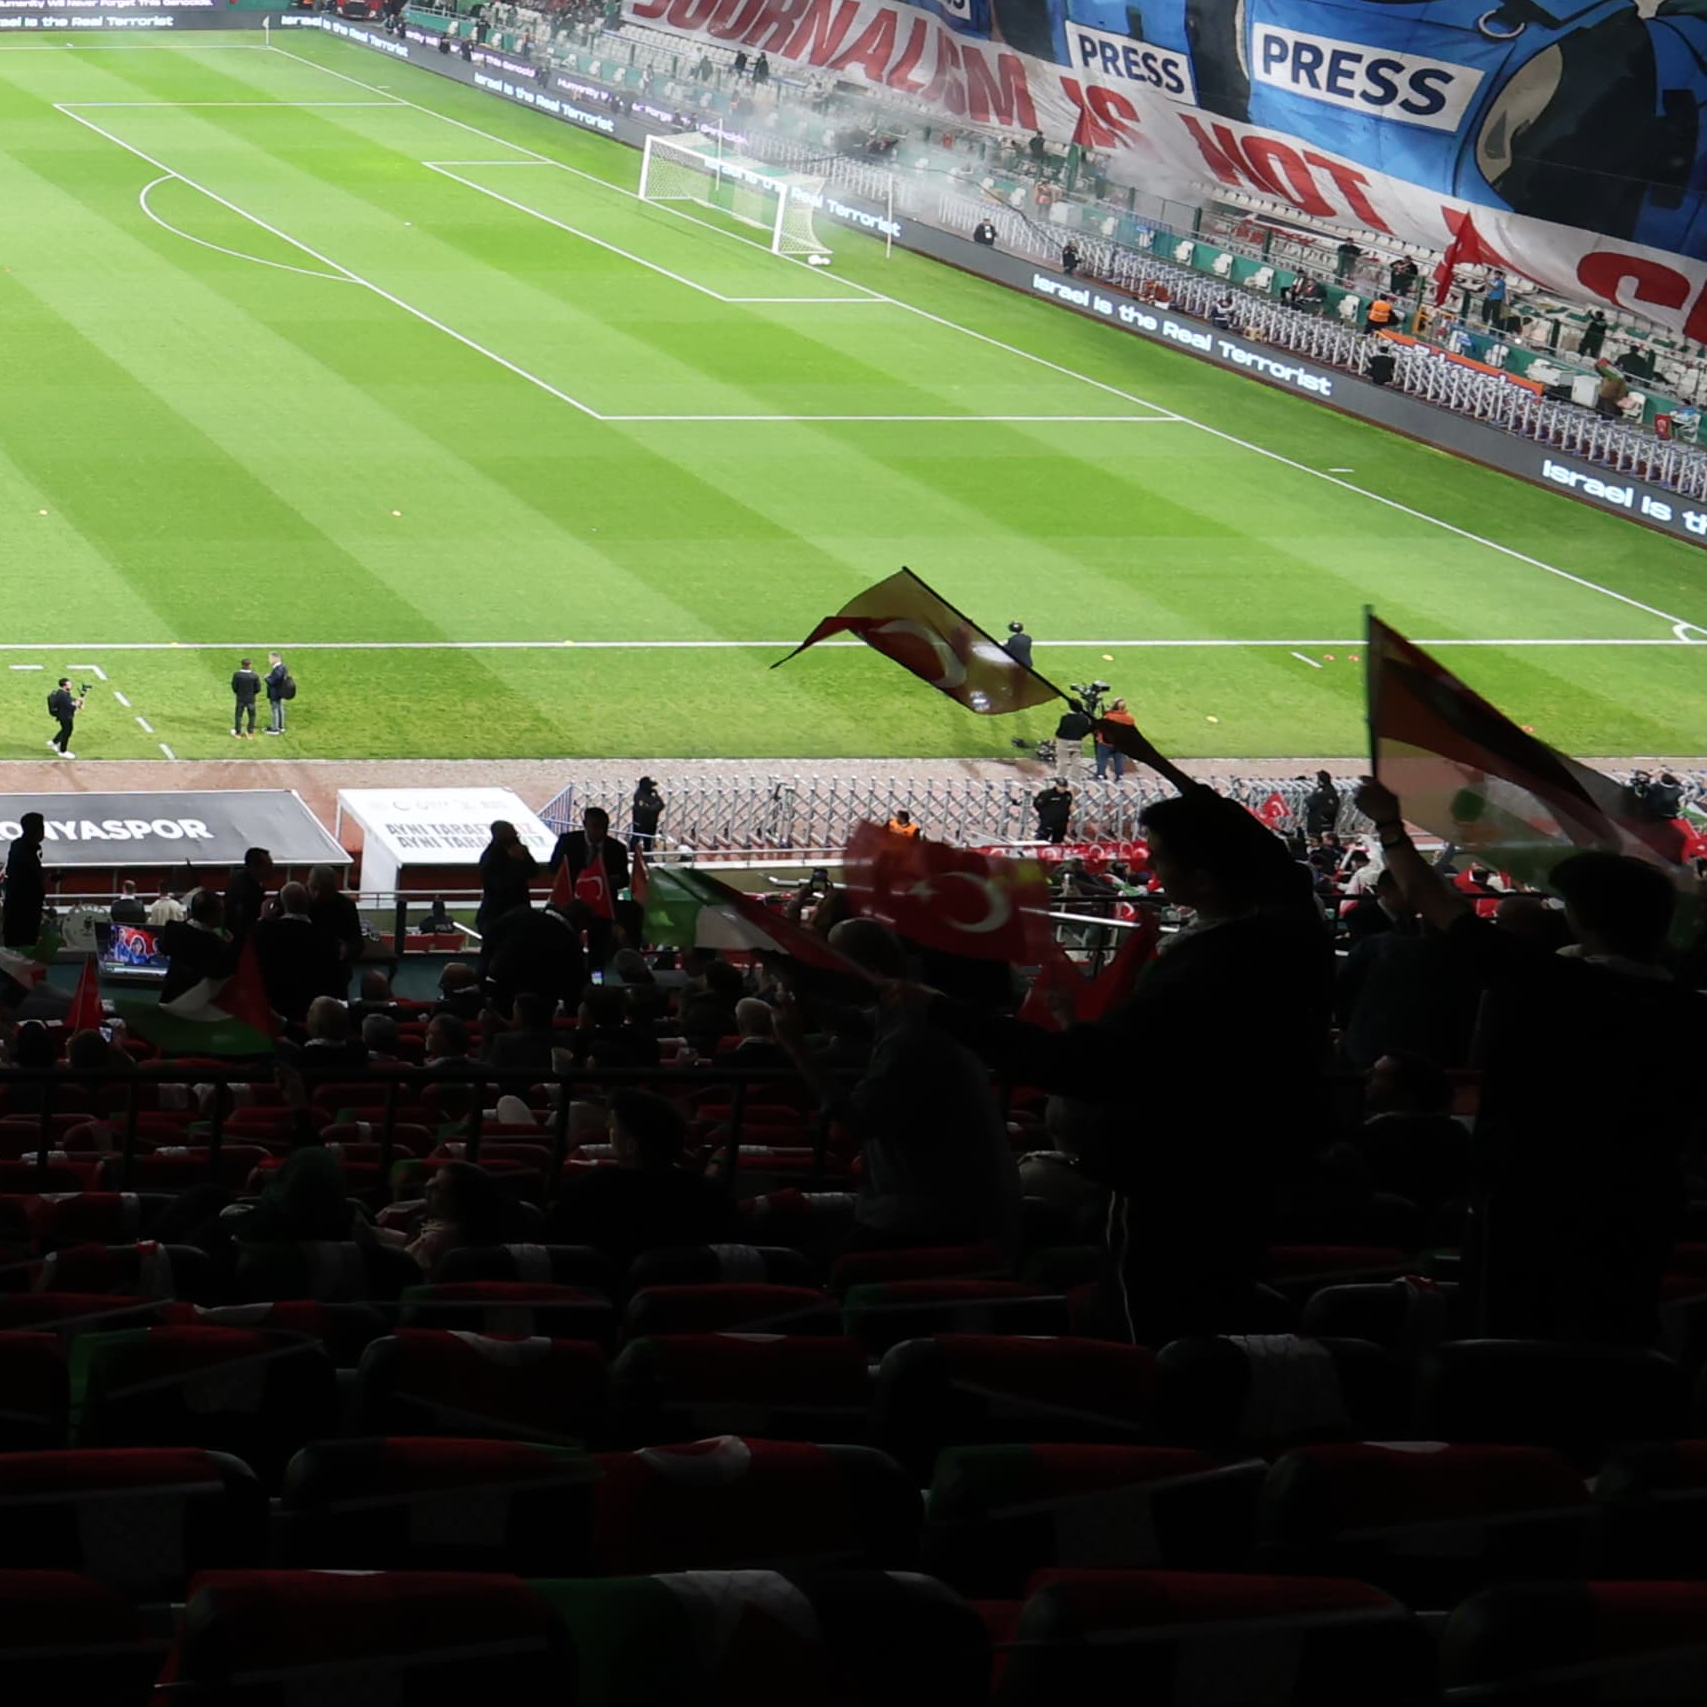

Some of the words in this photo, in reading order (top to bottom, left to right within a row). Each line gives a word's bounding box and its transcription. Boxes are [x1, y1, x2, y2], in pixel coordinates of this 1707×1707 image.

[1078, 32, 1187, 95] PRESS
[1260, 35, 1456, 116] PRESS
[475, 72, 502, 92] Israel
[515, 86, 534, 104] the
[536, 94, 560, 112] Real
[561, 102, 614, 133] Terrorist
[1059, 75, 1145, 150] IS
[1179, 112, 1395, 237] NOT
[790, 186, 823, 209] Real
[827, 199, 902, 237] Terrorist
[1033, 273, 1089, 306] Israel
[1118, 304, 1157, 331] the
[1163, 321, 1212, 352] Real
[1219, 339, 1332, 396] Terrorist
[1542, 459, 1634, 508] Israel
[386, 823, 429, 835] AYNI
[396, 836, 441, 849] AYNI
